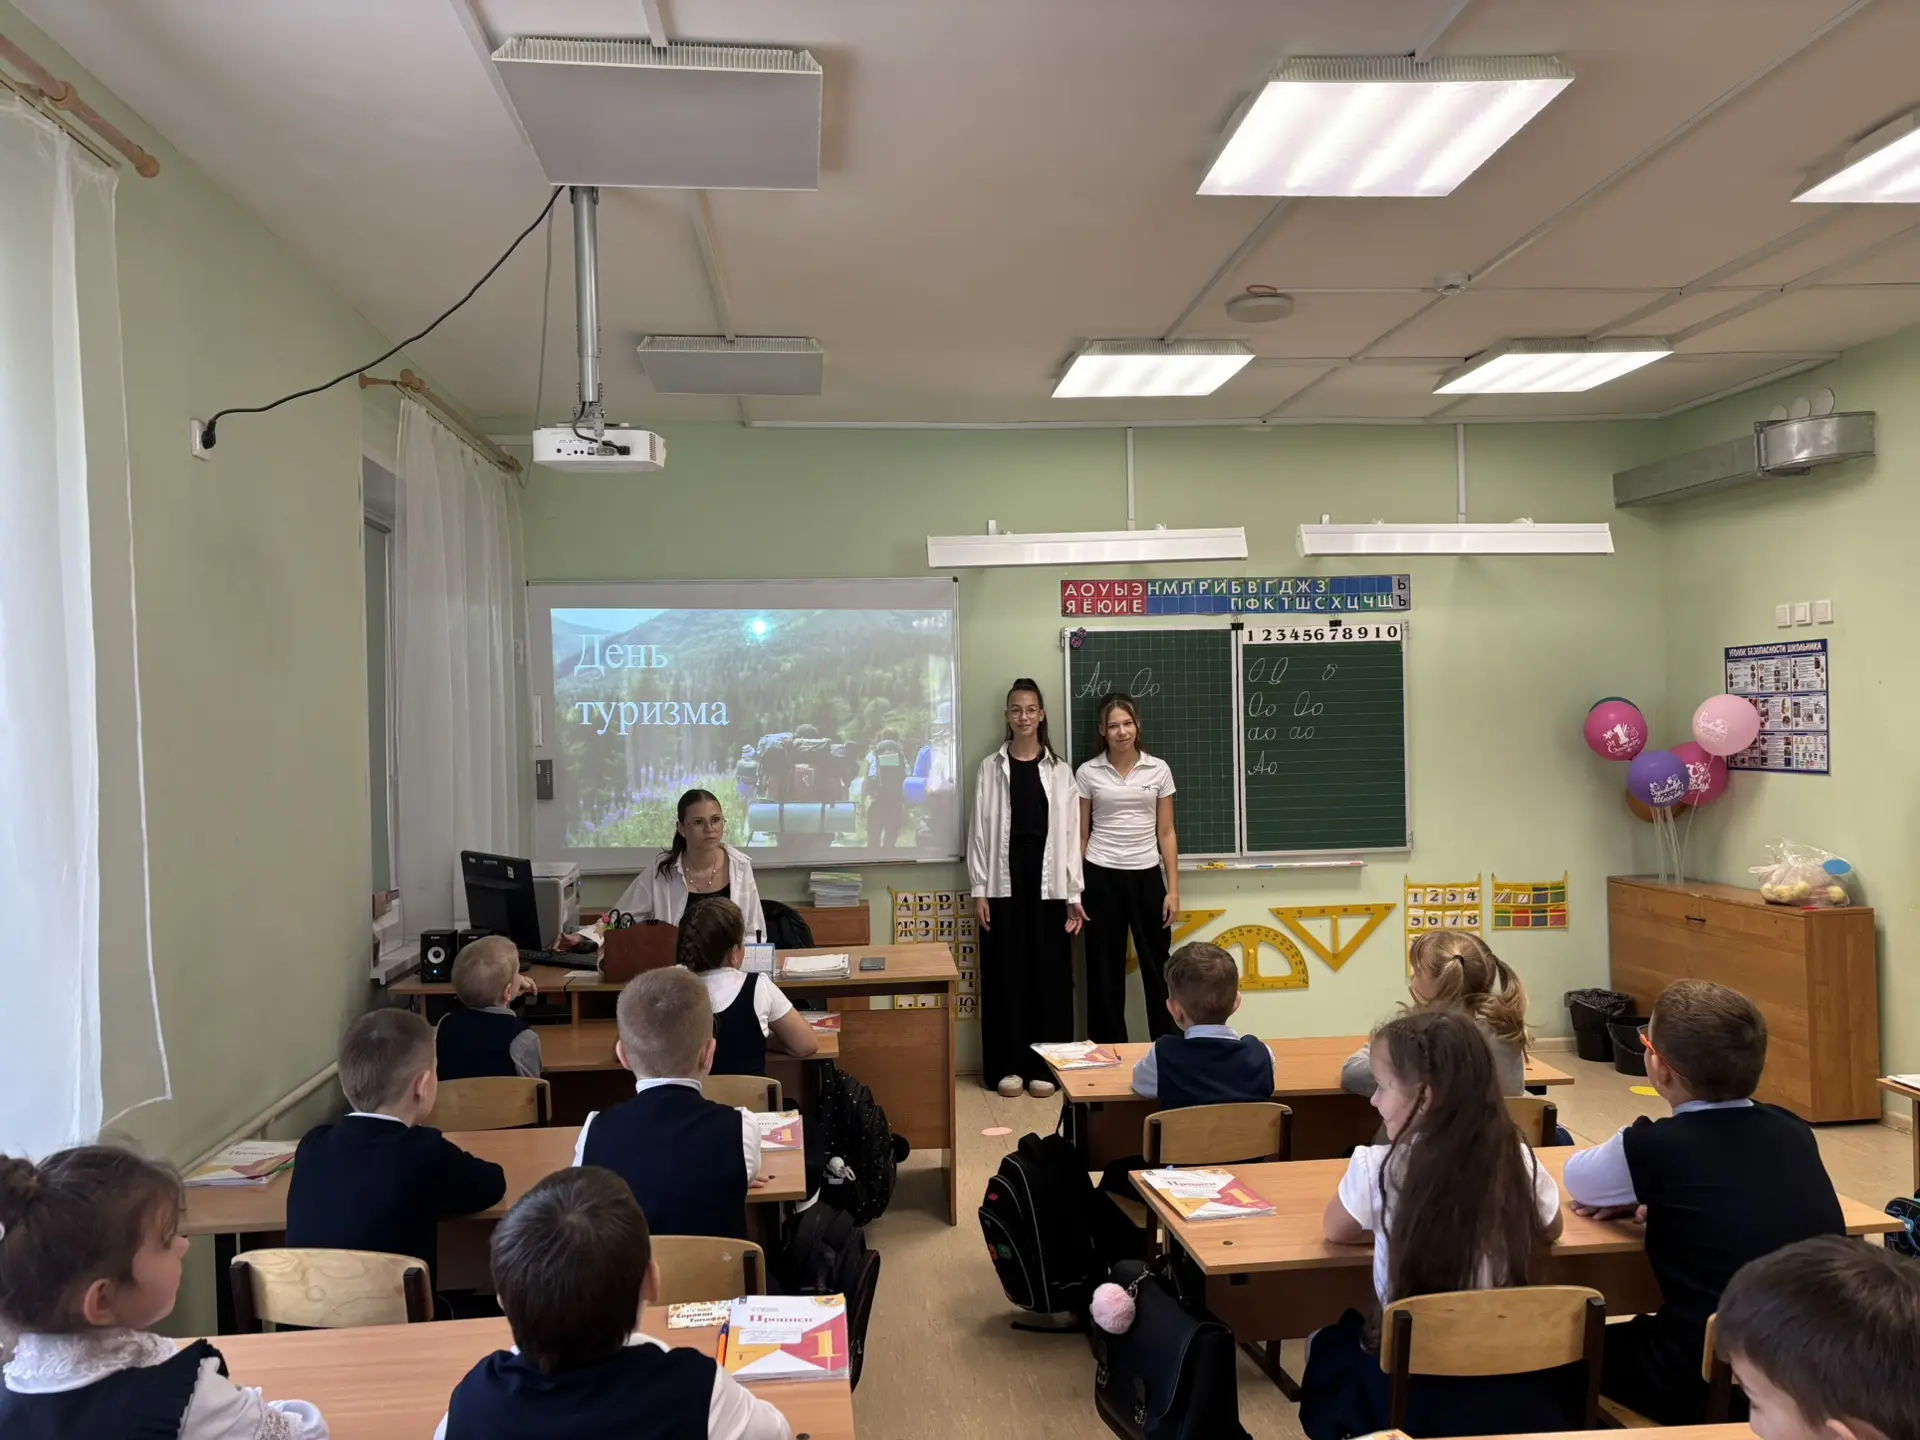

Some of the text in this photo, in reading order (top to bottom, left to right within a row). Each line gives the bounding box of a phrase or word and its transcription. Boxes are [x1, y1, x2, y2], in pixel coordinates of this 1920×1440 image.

[573, 634, 669, 677] День
[1728, 642, 1822, 657] УГОЛОК БЕЗОПАСНОСТИ ШКОЛЬНИКА
[574, 700, 730, 736] туризма
[962, 945, 974, 962] Р
[959, 997, 975, 1013] Ю
